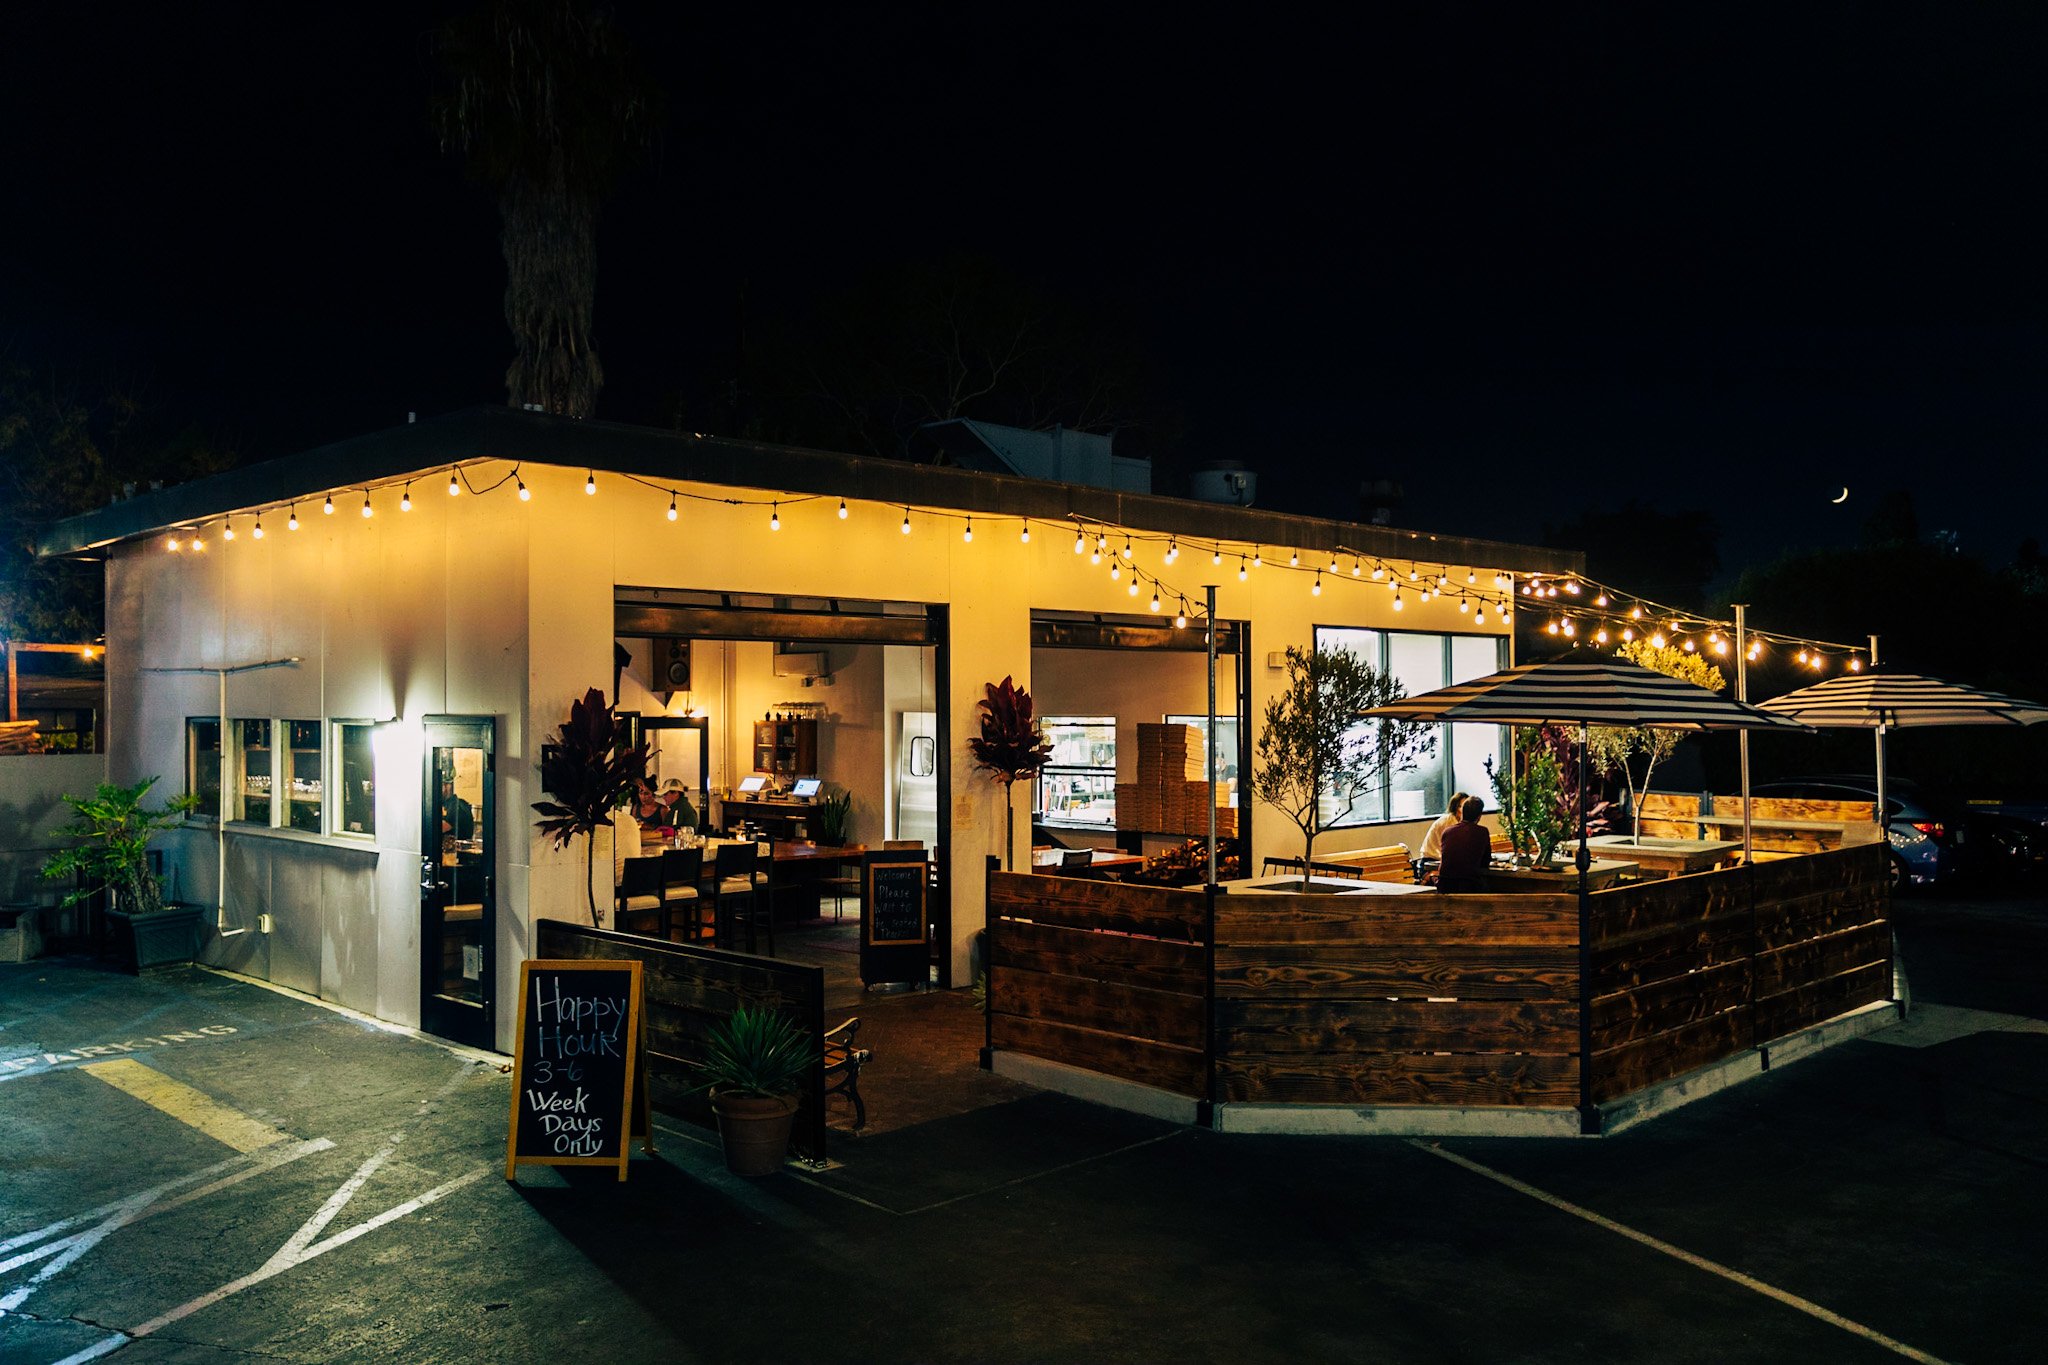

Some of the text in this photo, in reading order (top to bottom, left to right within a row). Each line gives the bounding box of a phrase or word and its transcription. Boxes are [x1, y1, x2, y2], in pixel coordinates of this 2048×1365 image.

[879, 885, 910, 898] Please
[536, 976, 626, 1037] Happy
[1, 1025, 238, 1070] PARKING
[534, 1061, 582, 1083] 3-6
[526, 1087, 589, 1113] Week
[538, 1114, 603, 1139] Days
[554, 1134, 603, 1156] Only
